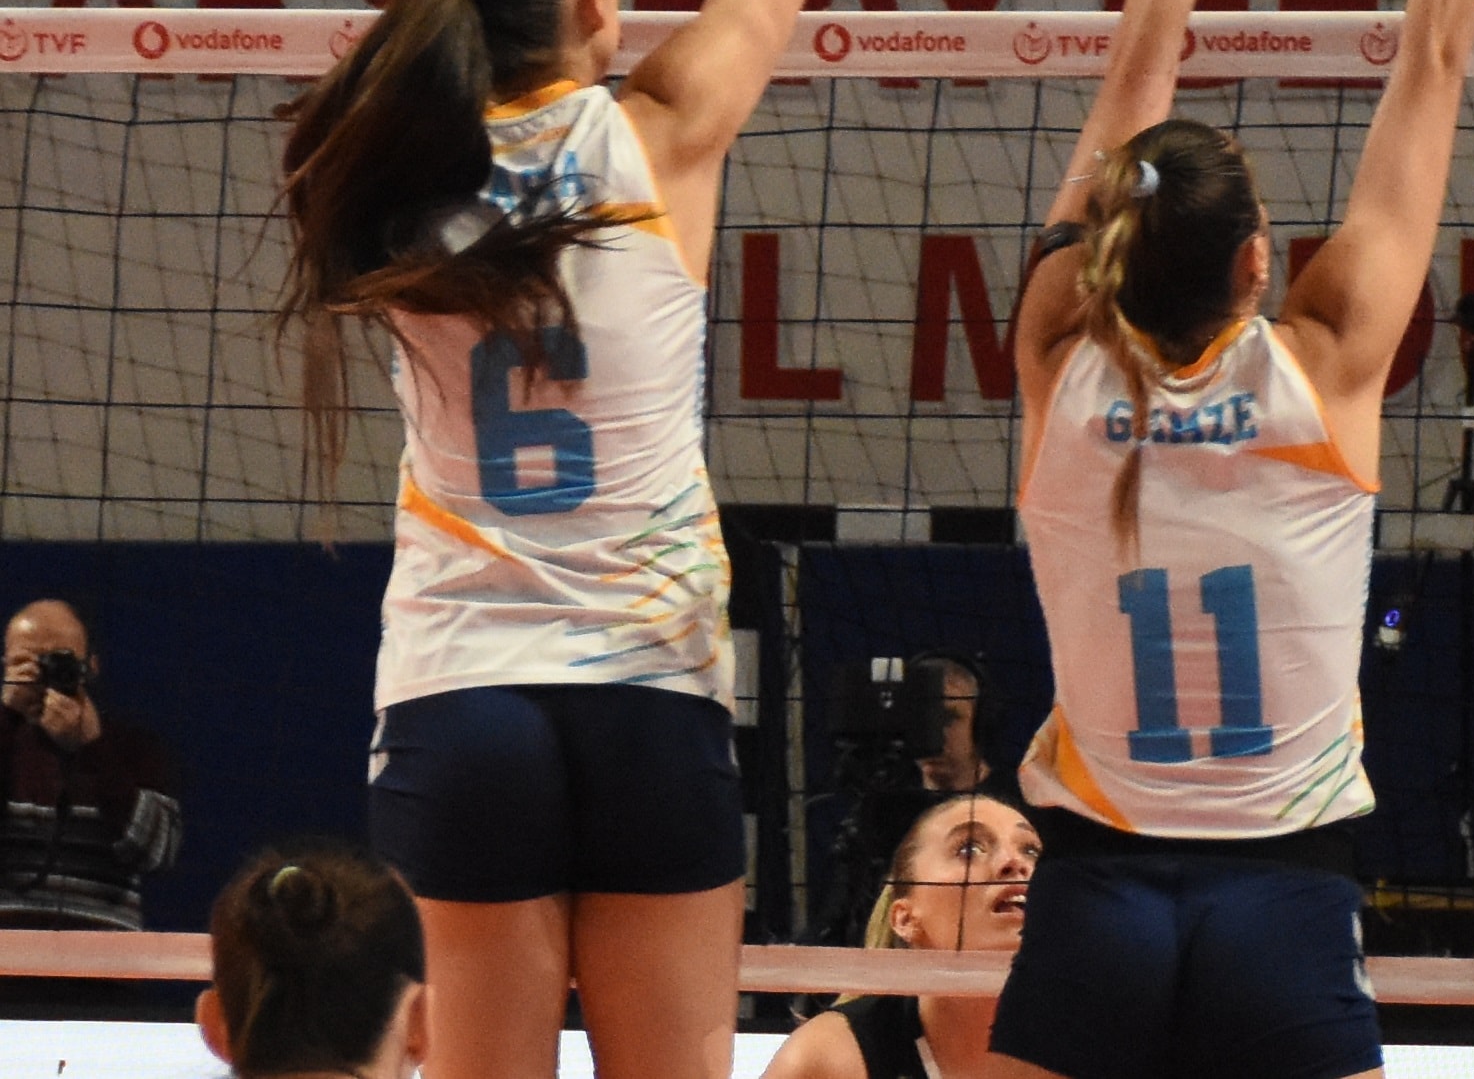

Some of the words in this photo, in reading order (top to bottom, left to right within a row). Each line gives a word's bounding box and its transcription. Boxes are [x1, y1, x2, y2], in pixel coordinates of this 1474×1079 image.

[33, 32, 86, 54] TVF
[176, 28, 283, 51] vodafone
[857, 30, 966, 53] vodafone
[1057, 35, 1110, 56] TVF
[1202, 30, 1312, 53] vodafone
[470, 324, 595, 517] 6
[1118, 565, 1274, 763] 11
